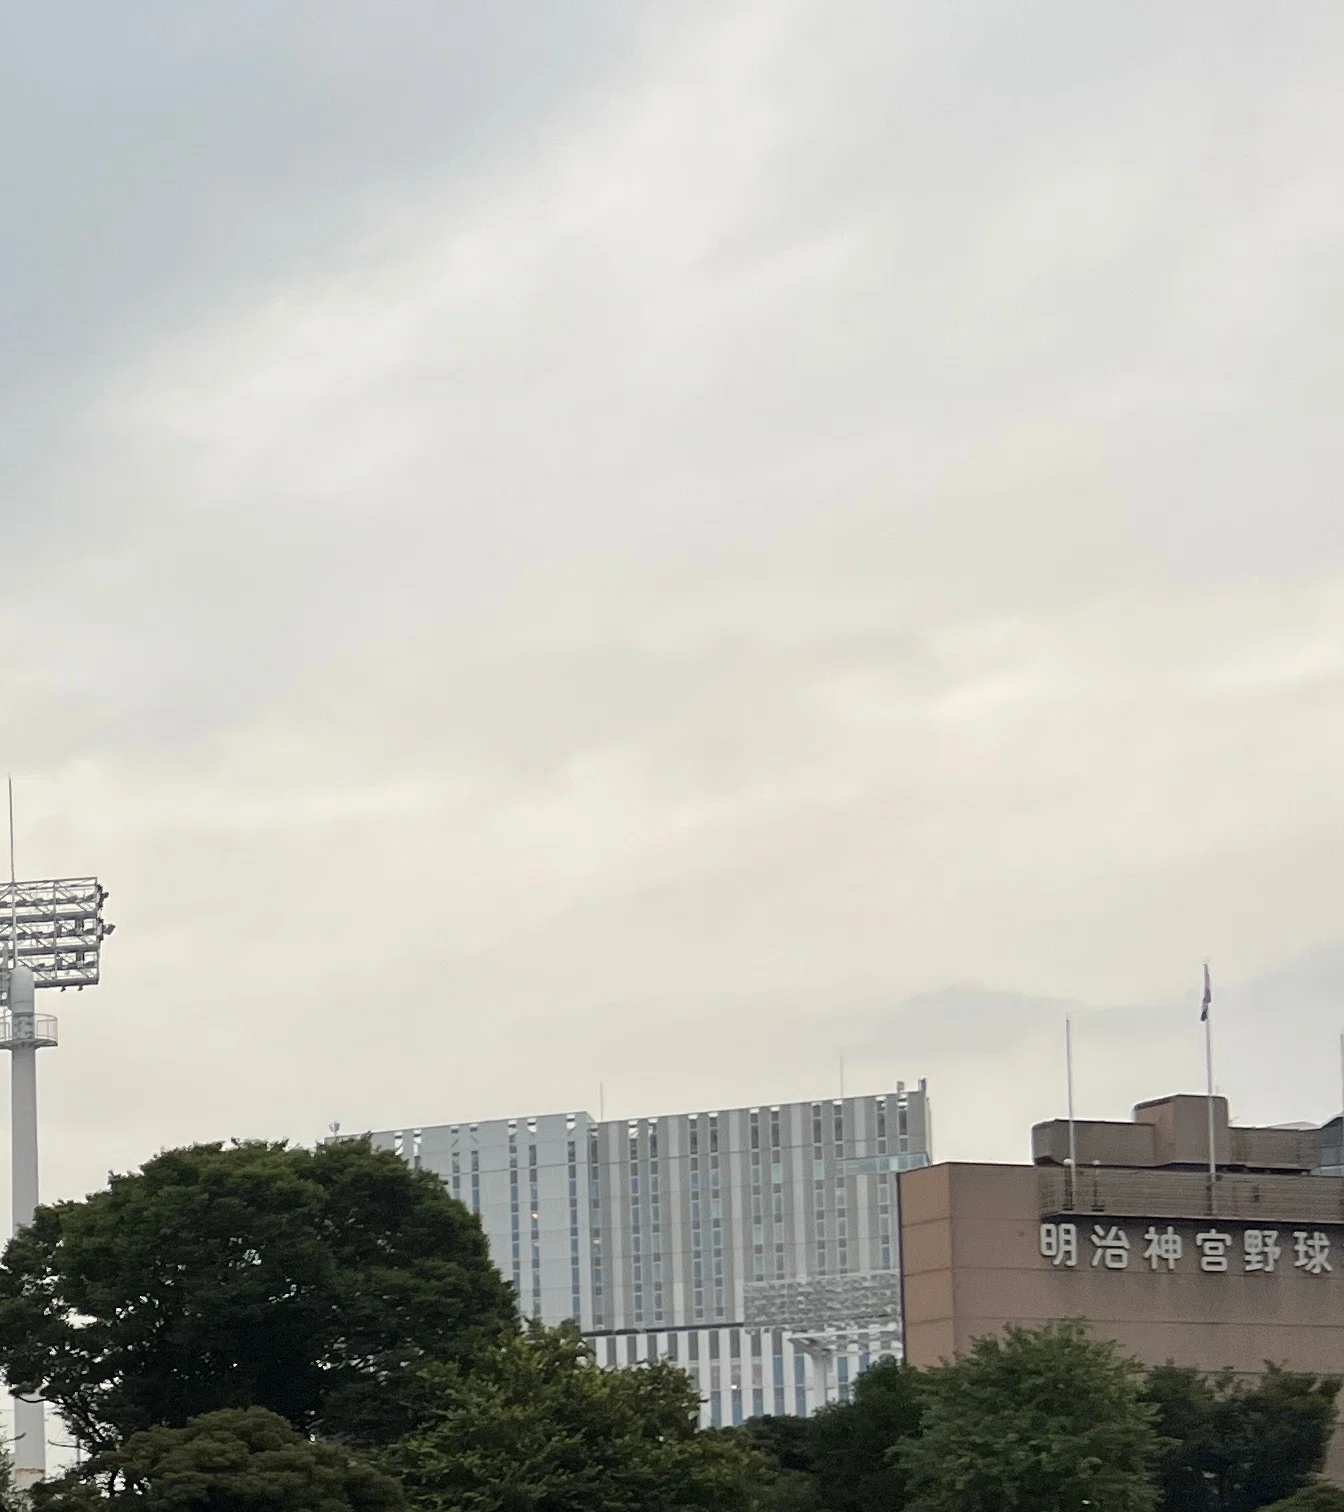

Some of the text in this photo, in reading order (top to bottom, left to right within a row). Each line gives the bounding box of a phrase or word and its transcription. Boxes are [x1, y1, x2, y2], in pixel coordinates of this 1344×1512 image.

[1038, 1222, 1333, 1274] 明治神宮野球
